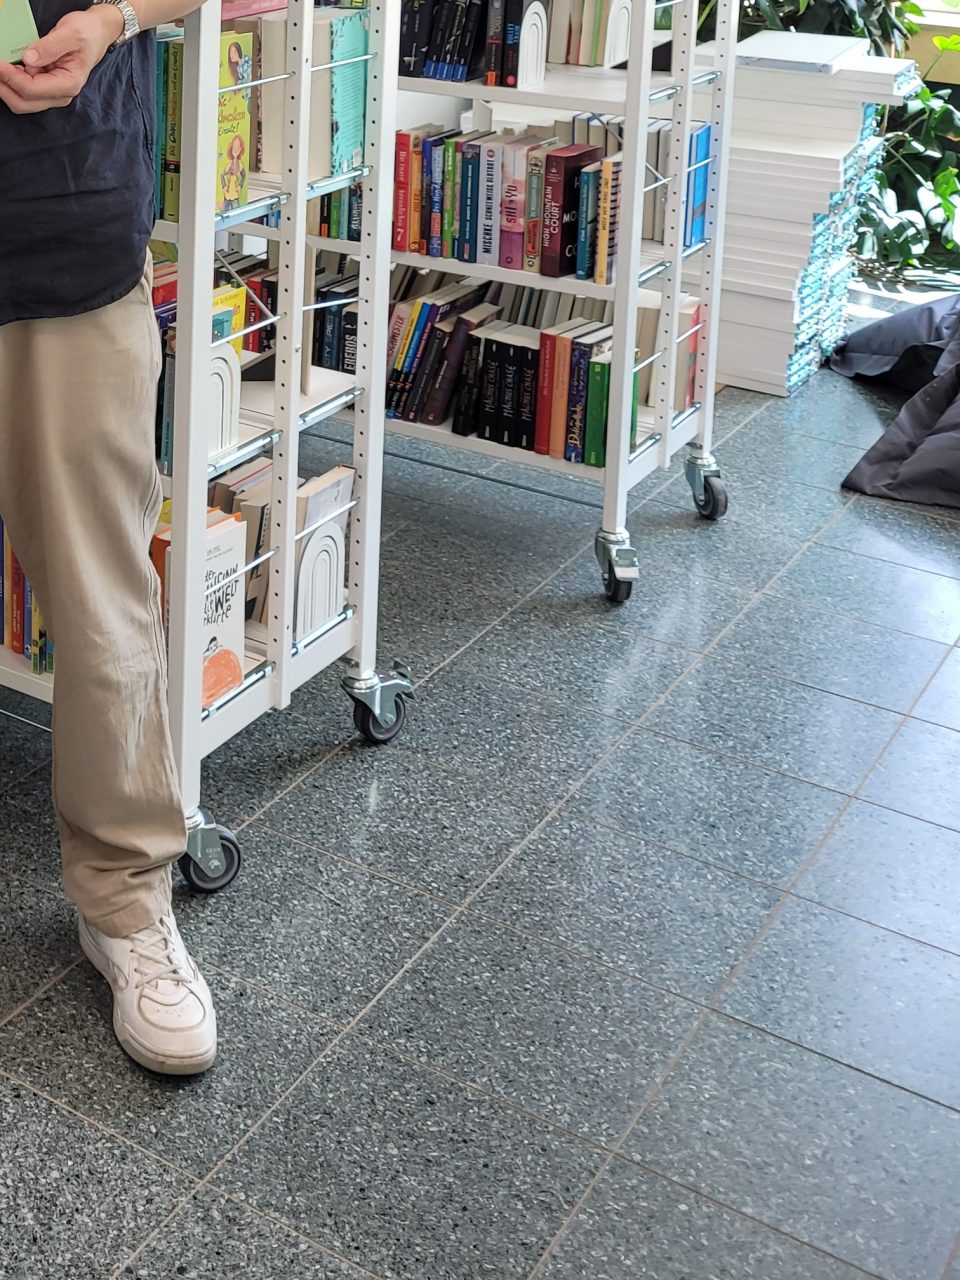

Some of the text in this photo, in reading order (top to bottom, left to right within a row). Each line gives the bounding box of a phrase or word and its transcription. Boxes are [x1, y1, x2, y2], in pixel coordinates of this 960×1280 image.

[505, 185, 517, 223] SHI YU
[544, 185, 553, 225] MOUNTAIN
[550, 201, 559, 234] COURT
[483, 224, 493, 254] MISCHKE
[344, 335, 356, 370] EREBOS
[214, 579, 240, 615] WELT
